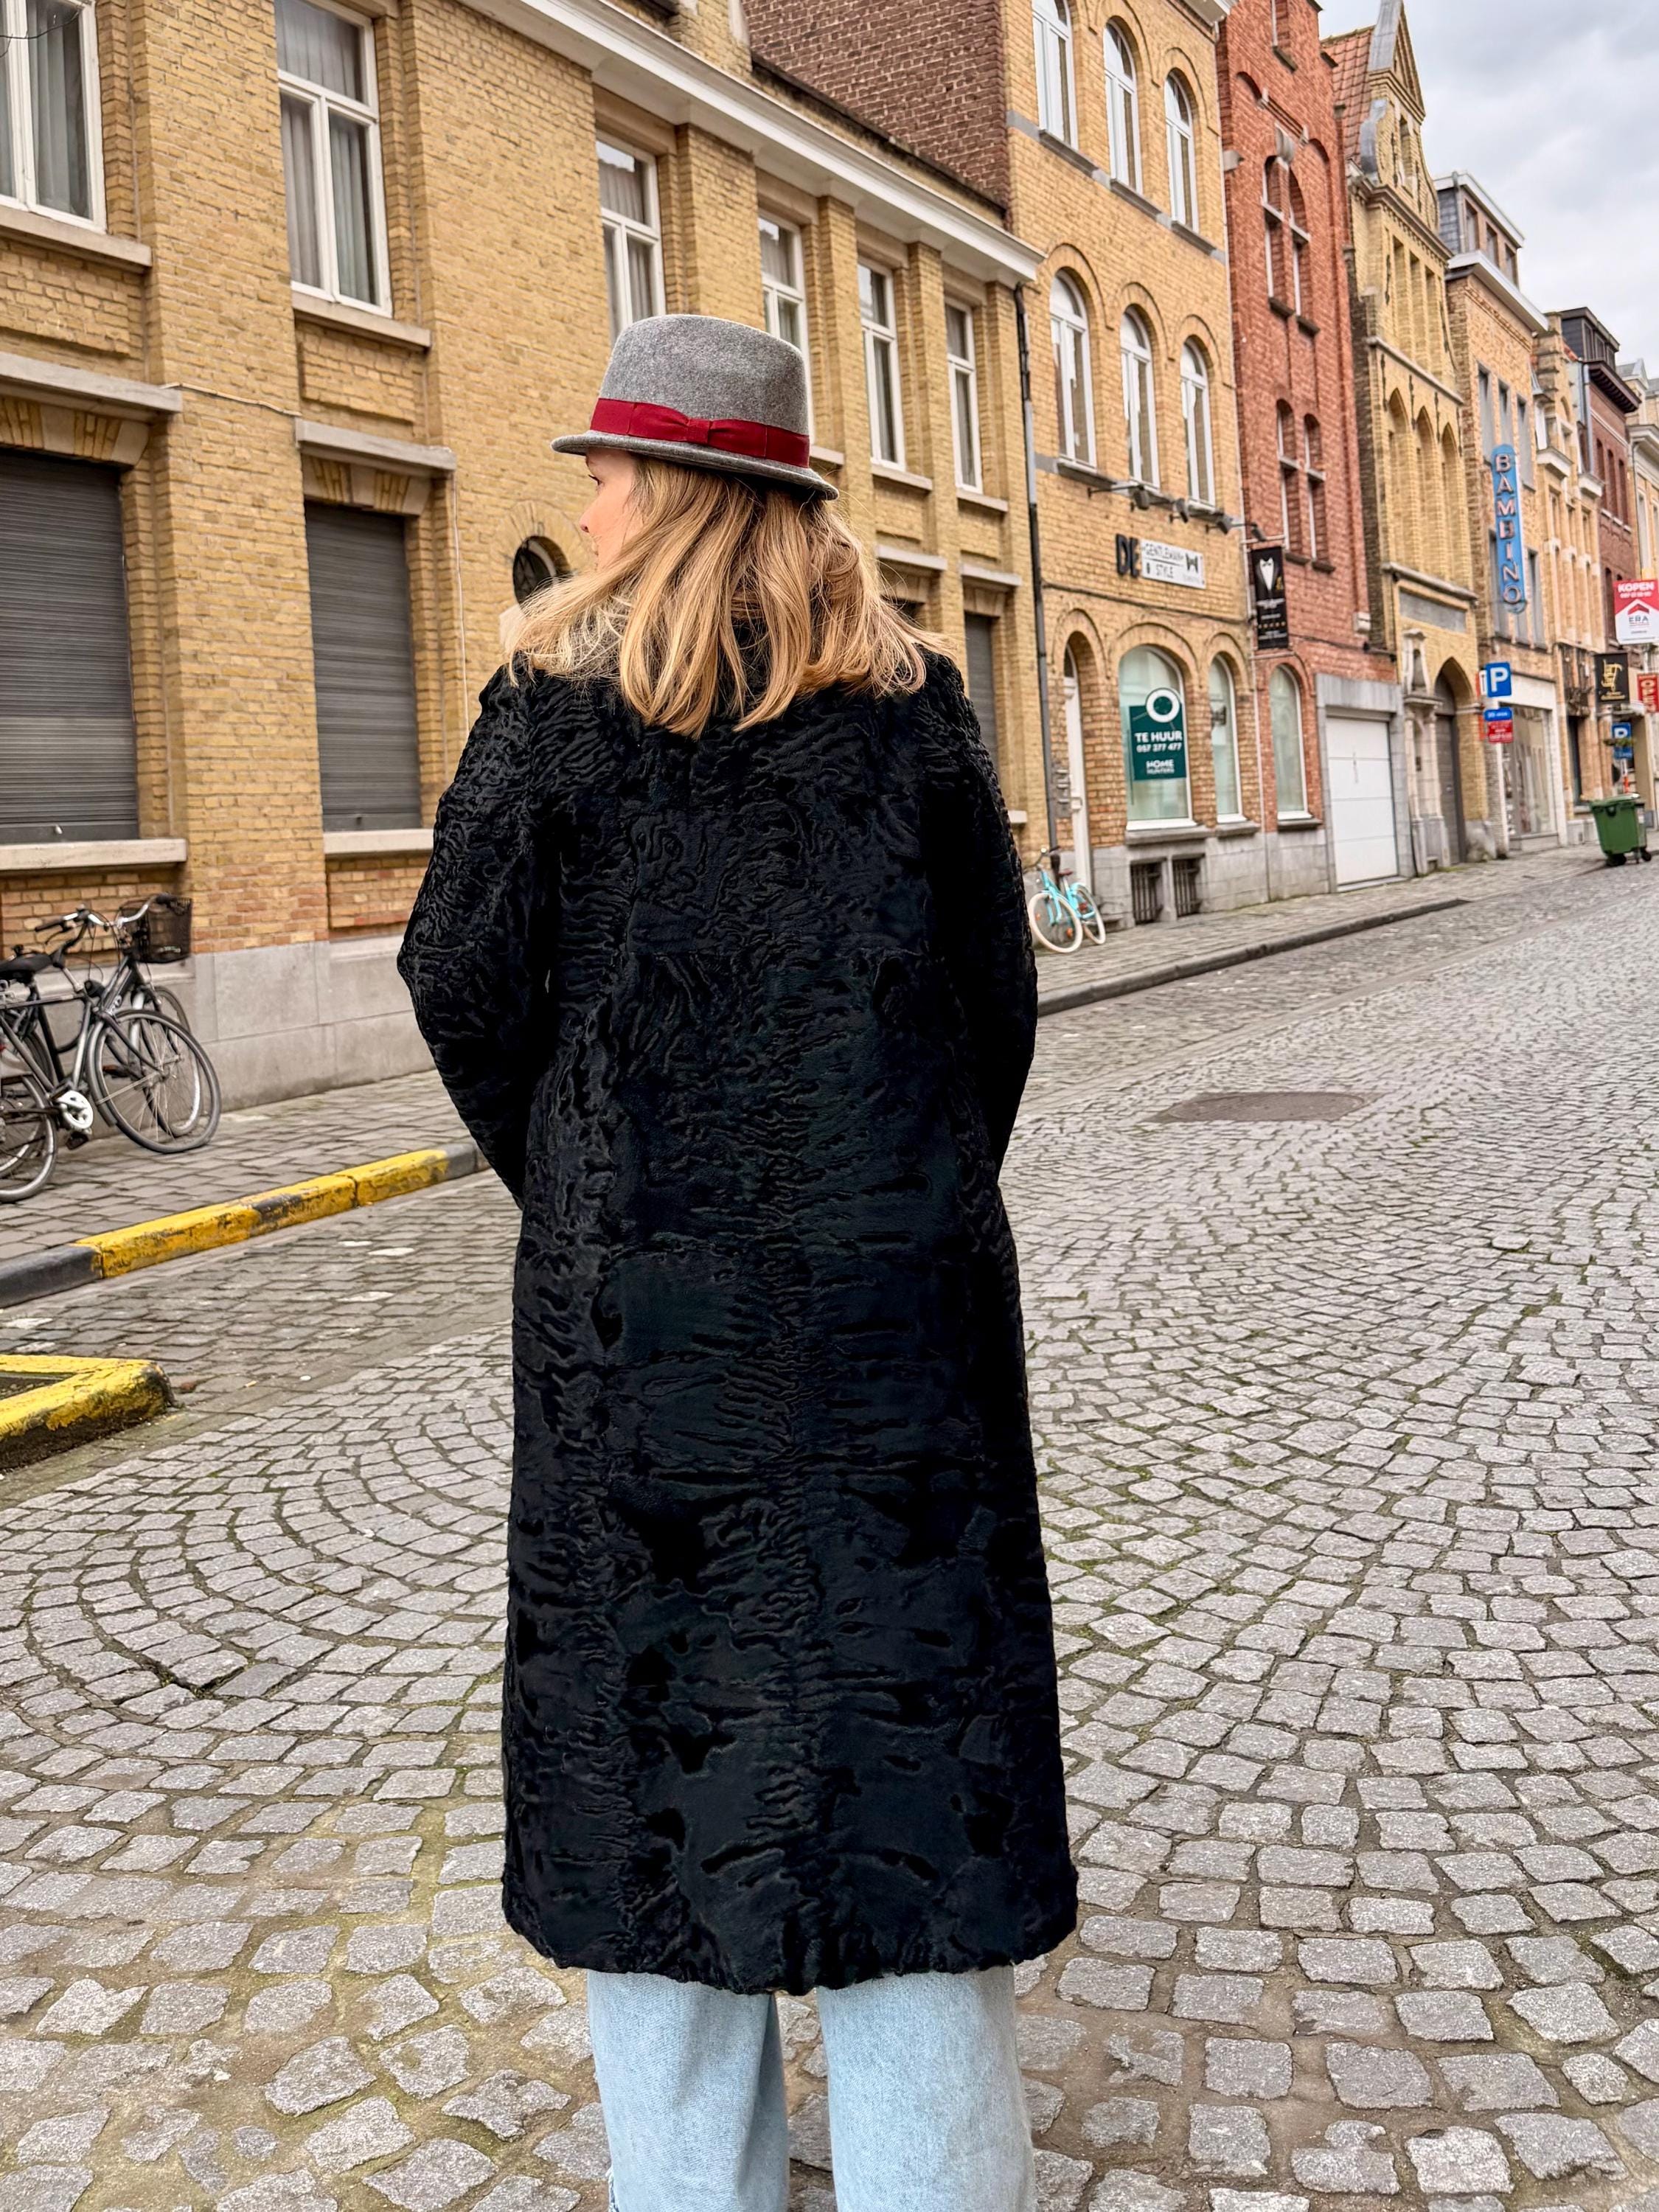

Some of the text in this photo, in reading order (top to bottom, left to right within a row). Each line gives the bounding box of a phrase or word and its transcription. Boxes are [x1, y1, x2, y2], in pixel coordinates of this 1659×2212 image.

[1495, 453, 1523, 605] BAMBINO
[1116, 534, 1140, 578] DE
[1618, 582, 1655, 593] KOPEN
[1490, 667, 1509, 692] P
[1135, 731, 1183, 743] TE HUUR
[1146, 759, 1175, 768] HOME
